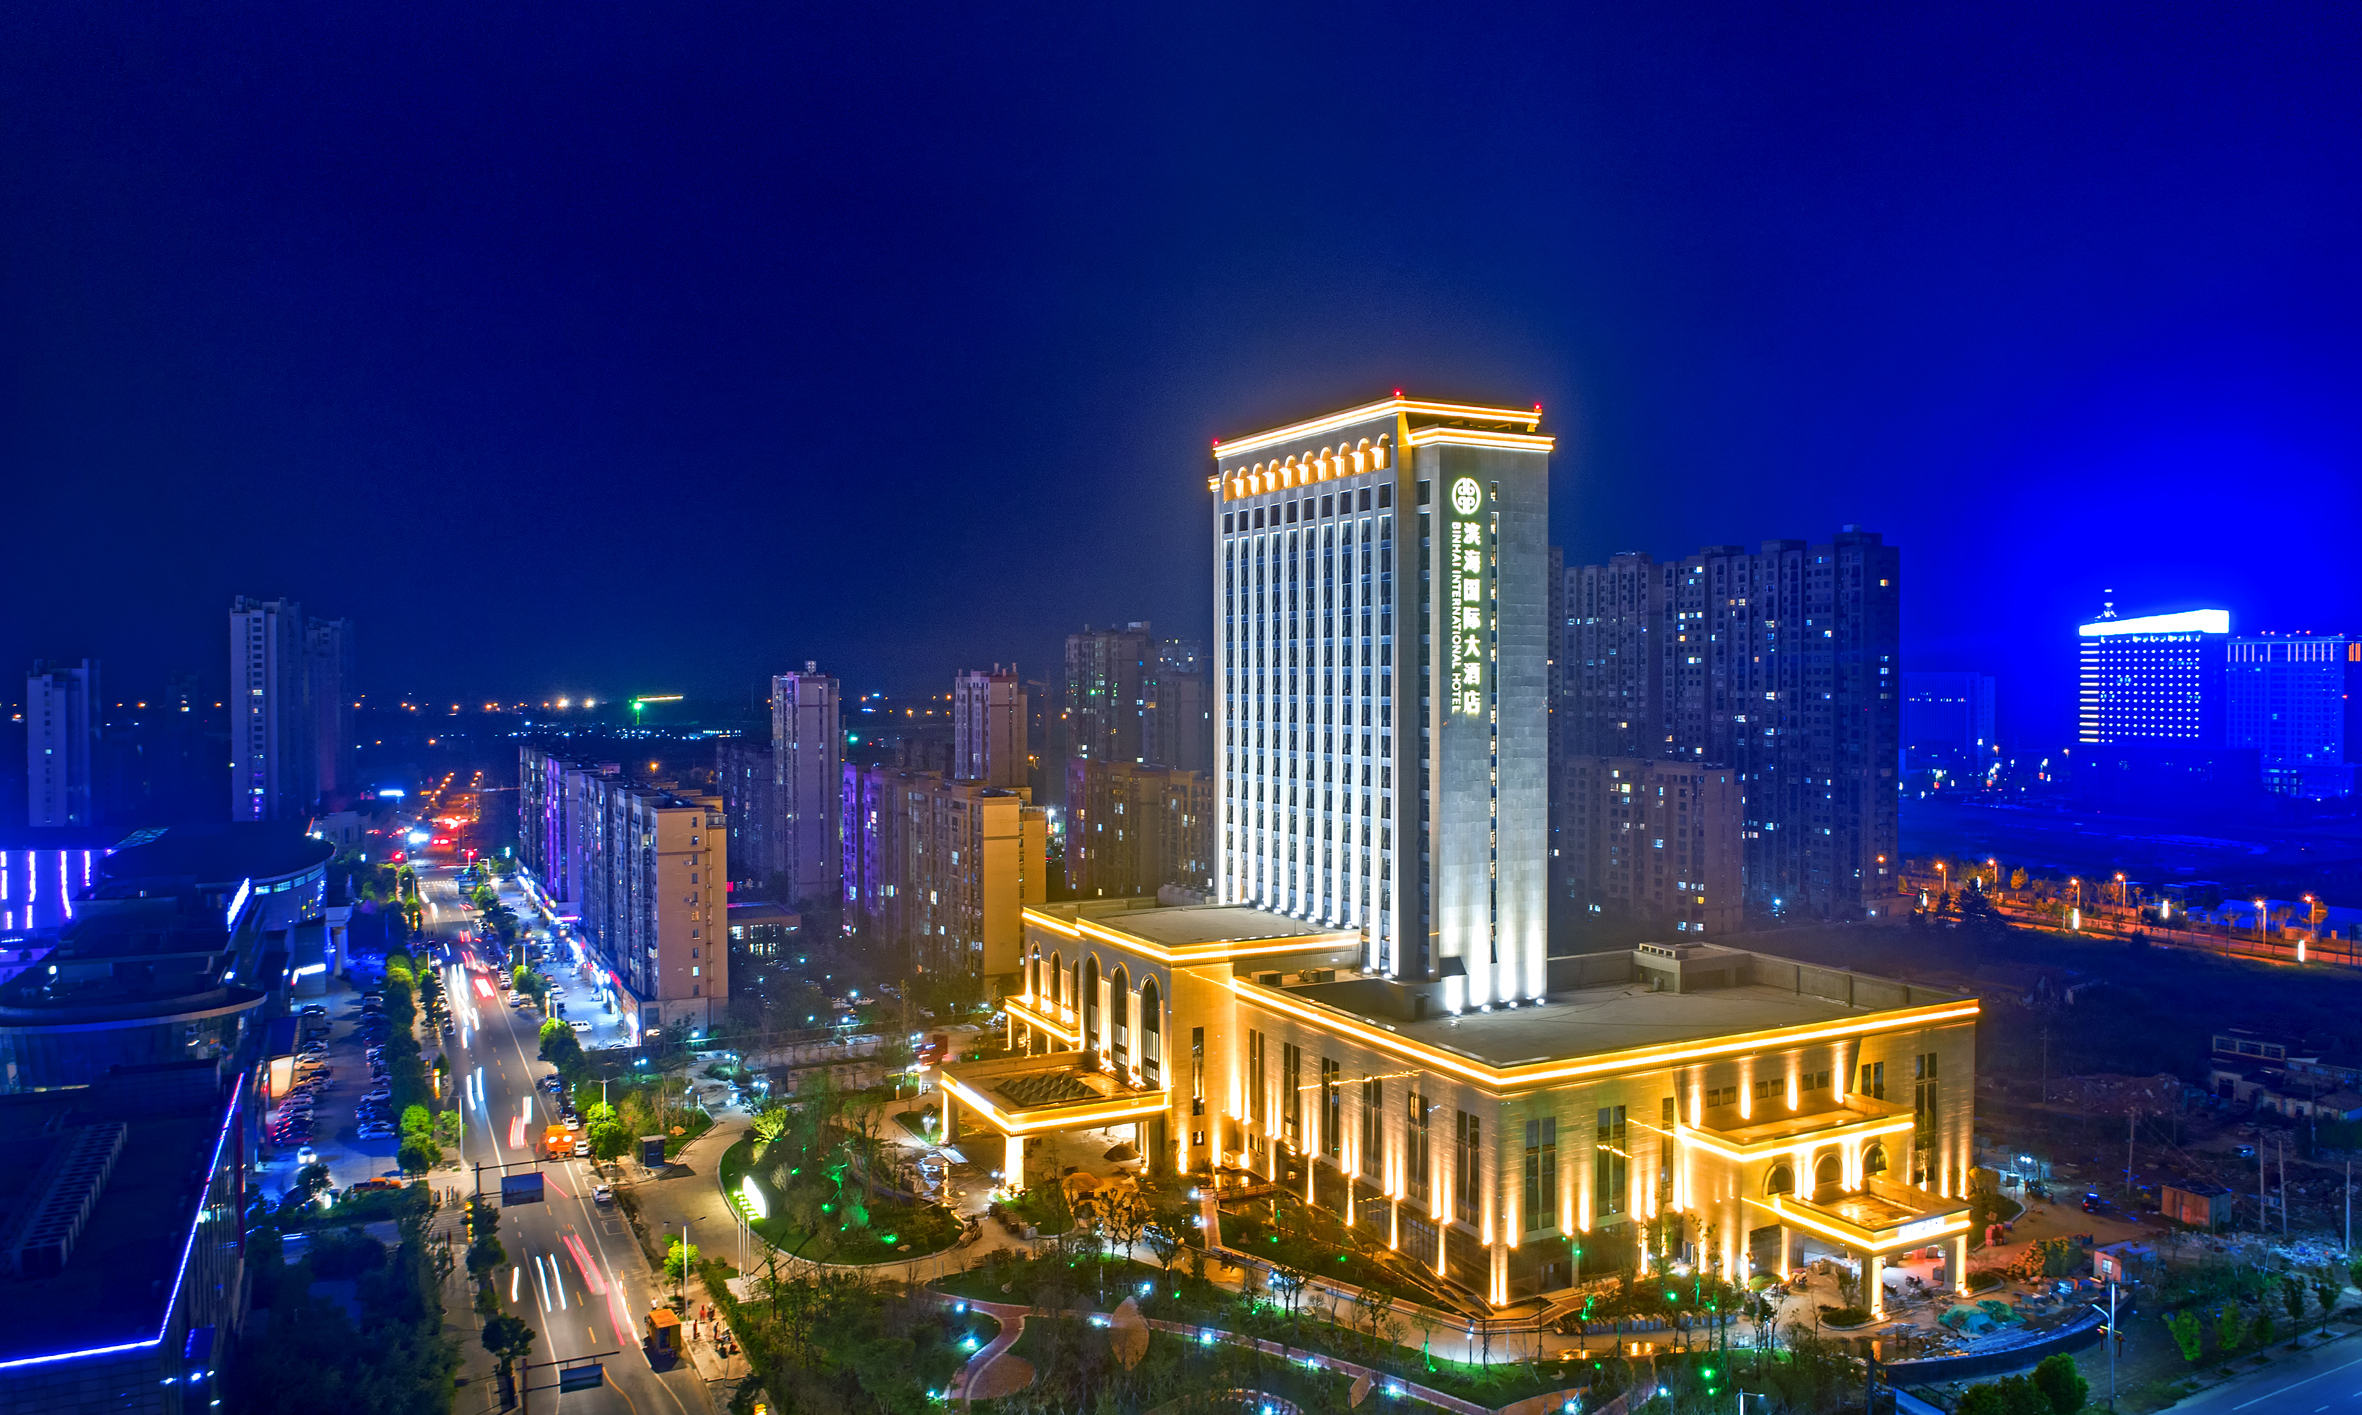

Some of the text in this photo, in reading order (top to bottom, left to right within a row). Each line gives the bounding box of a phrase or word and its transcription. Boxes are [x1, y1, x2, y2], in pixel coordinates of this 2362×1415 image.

[1451, 522, 1462, 713] BINHAI INTERNATIONAL HOTEL
[1463, 522, 1481, 714] 滨海国际大酒店
